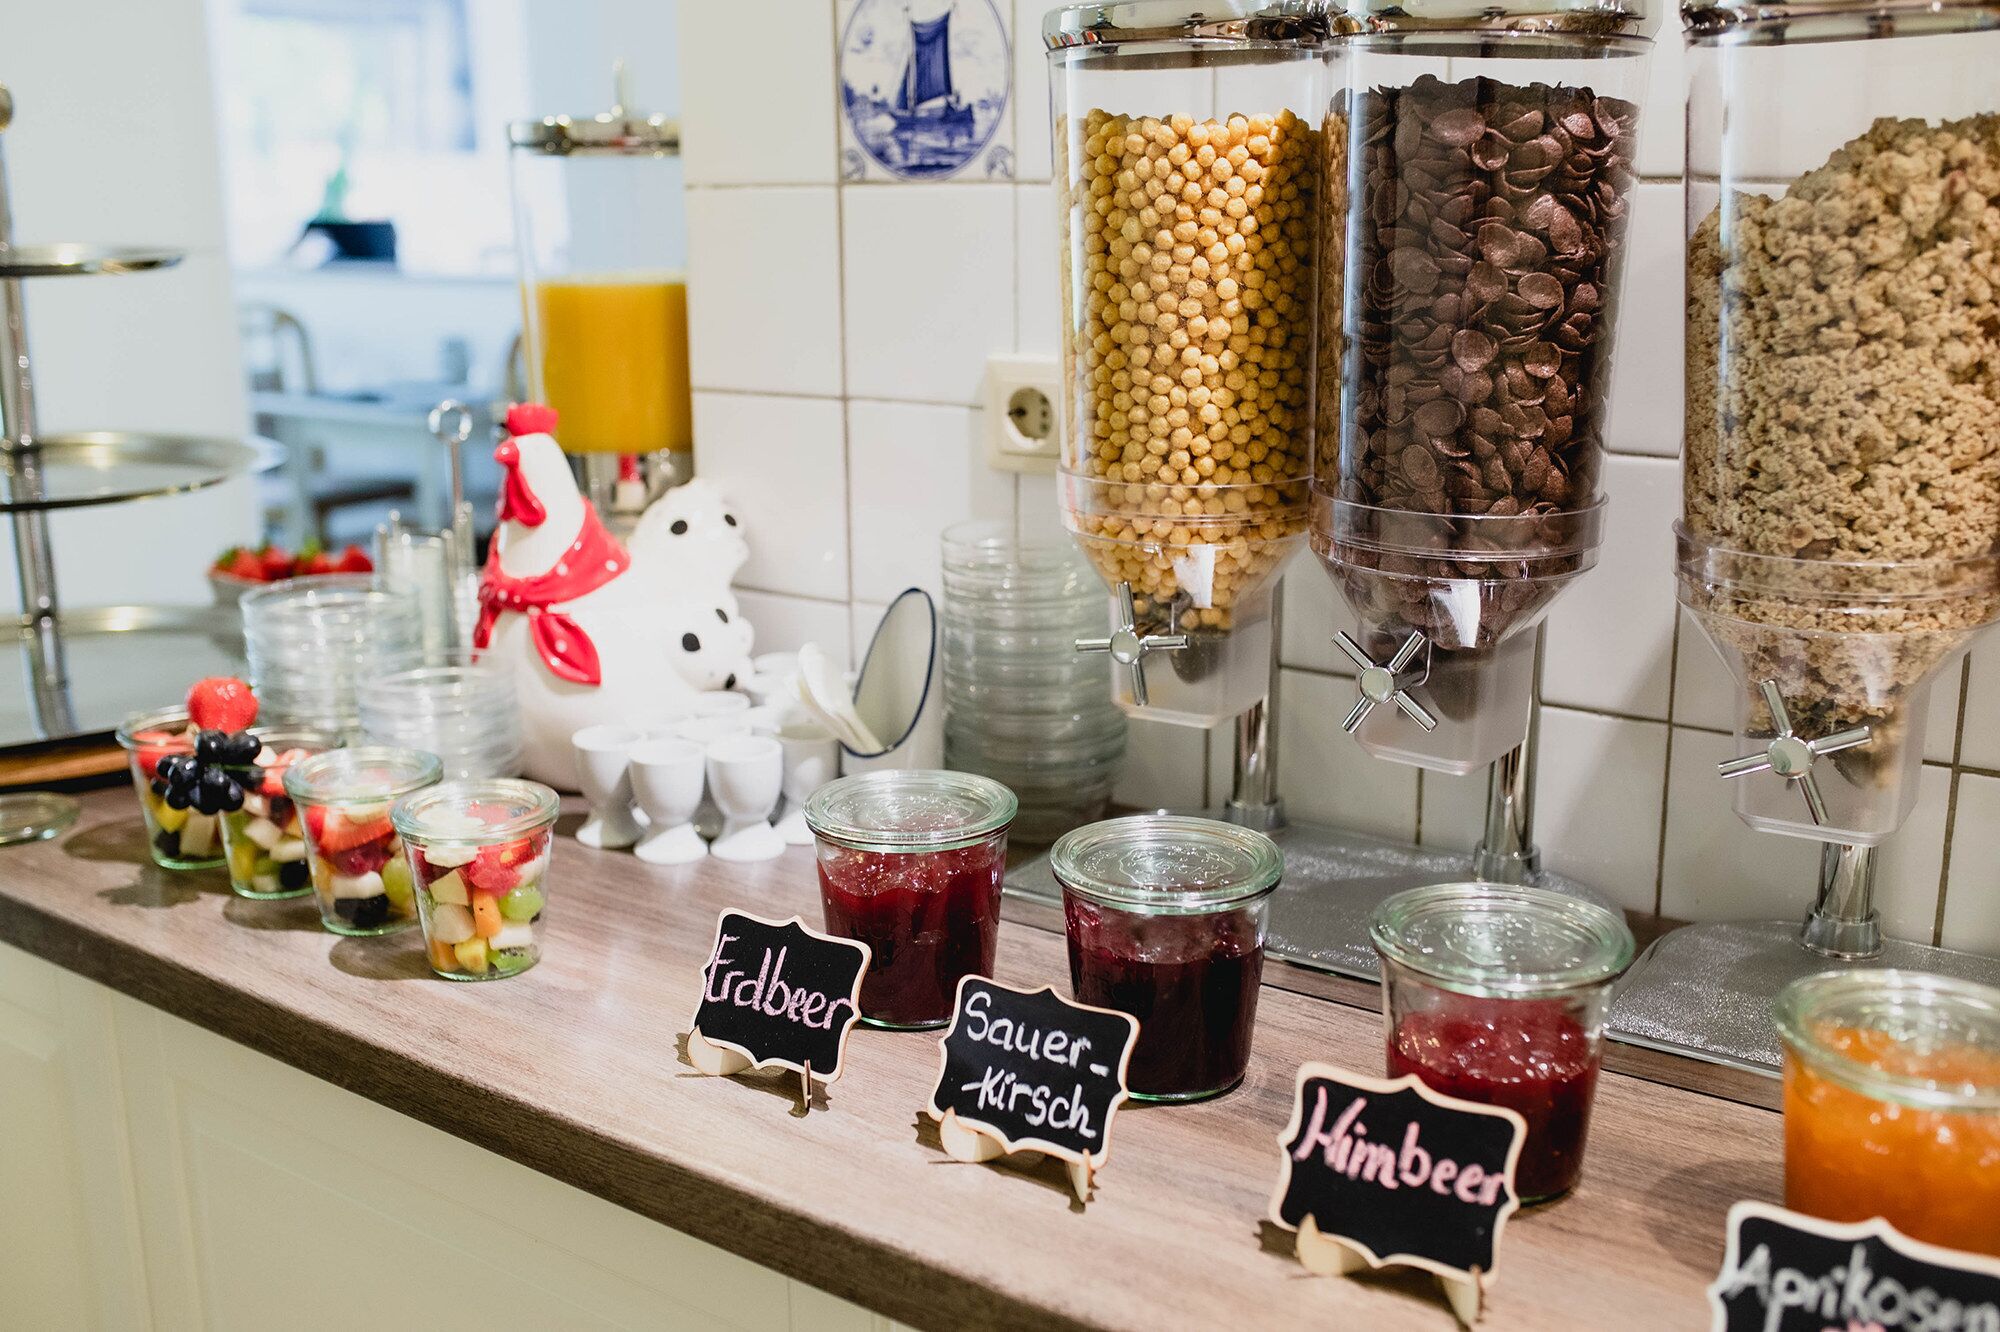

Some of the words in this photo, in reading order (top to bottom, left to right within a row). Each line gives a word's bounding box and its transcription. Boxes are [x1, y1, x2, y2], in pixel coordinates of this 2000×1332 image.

[705, 934, 854, 1030] Erdbeer
[965, 991, 1109, 1077] Sauer-
[1292, 1085, 1505, 1206] Himbeer
